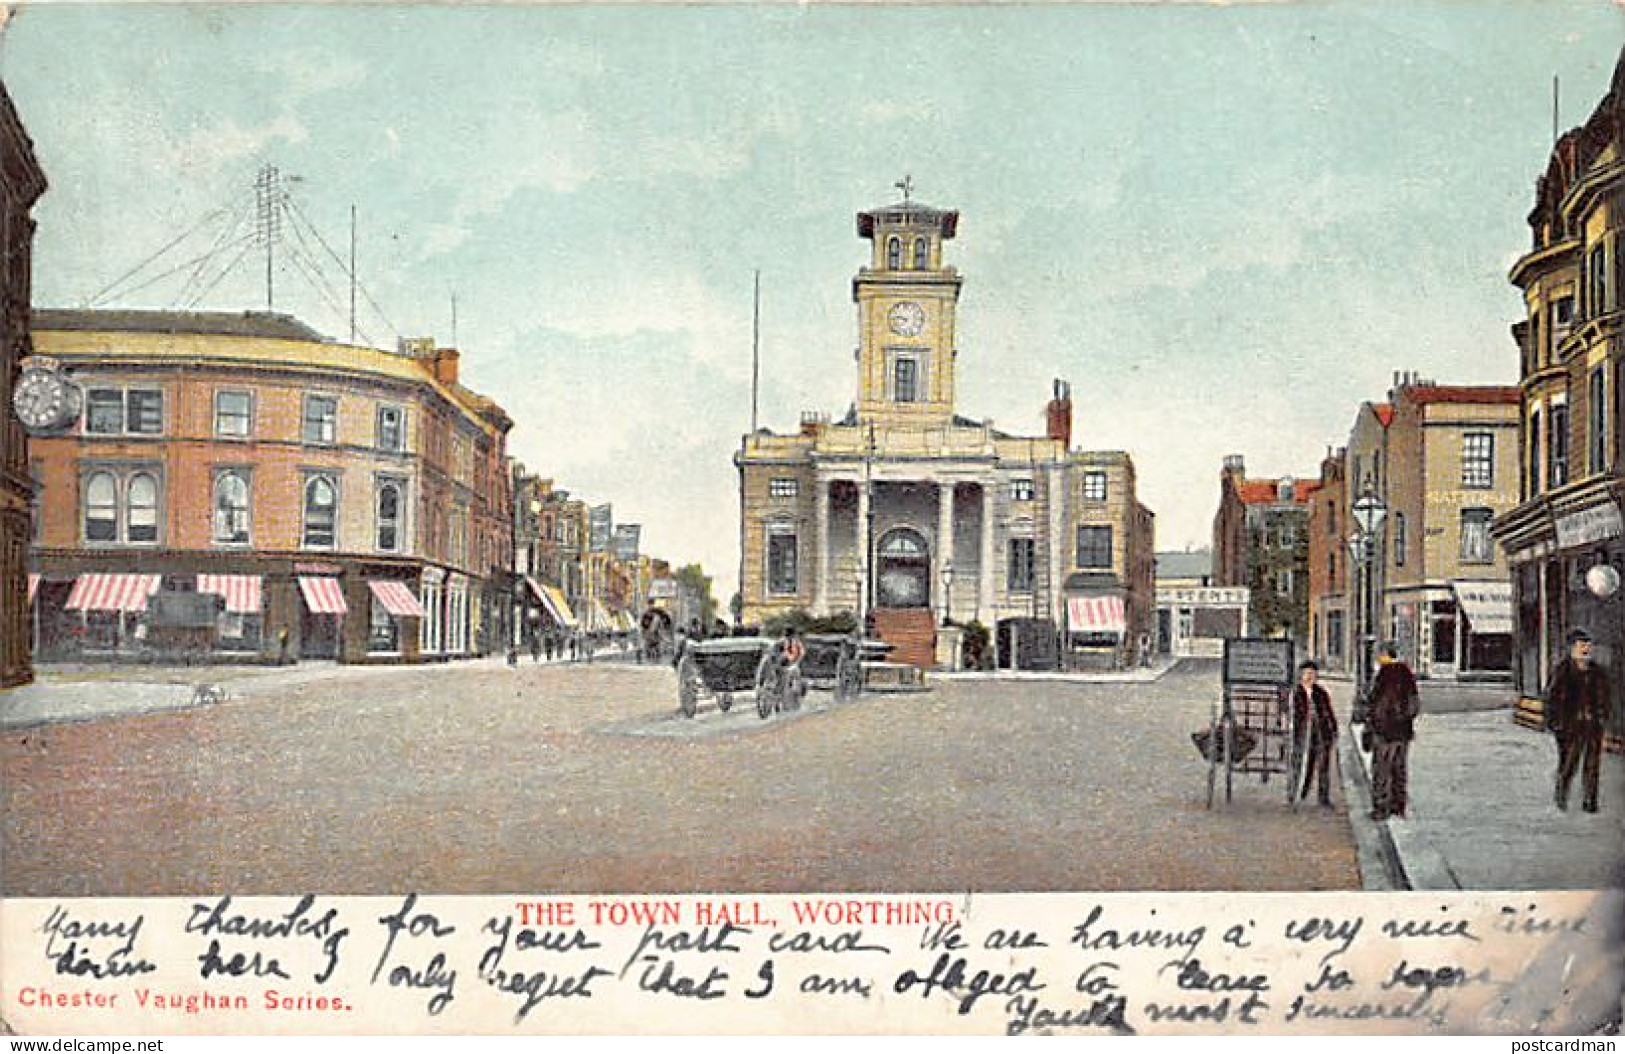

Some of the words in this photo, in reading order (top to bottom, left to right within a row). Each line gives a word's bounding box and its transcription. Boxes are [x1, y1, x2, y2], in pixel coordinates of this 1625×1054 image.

[515, 902, 574, 925] THE
[588, 902, 681, 925] TOWN
[695, 902, 777, 927] HALL,
[370, 893, 456, 984] for
[478, 917, 601, 978] your
[618, 922, 752, 980] post
[769, 929, 890, 953] card
[921, 920, 968, 950] We
[984, 929, 1048, 949] are
[1072, 905, 1207, 975] having
[1284, 916, 1364, 967] very
[1382, 904, 1481, 942] nice
[198, 939, 290, 979] here
[638, 956, 729, 999] that
[744, 960, 774, 998] I
[1076, 961, 1119, 994] to
[17, 986, 118, 1007] Chester
[135, 989, 248, 1013] Vaughan
